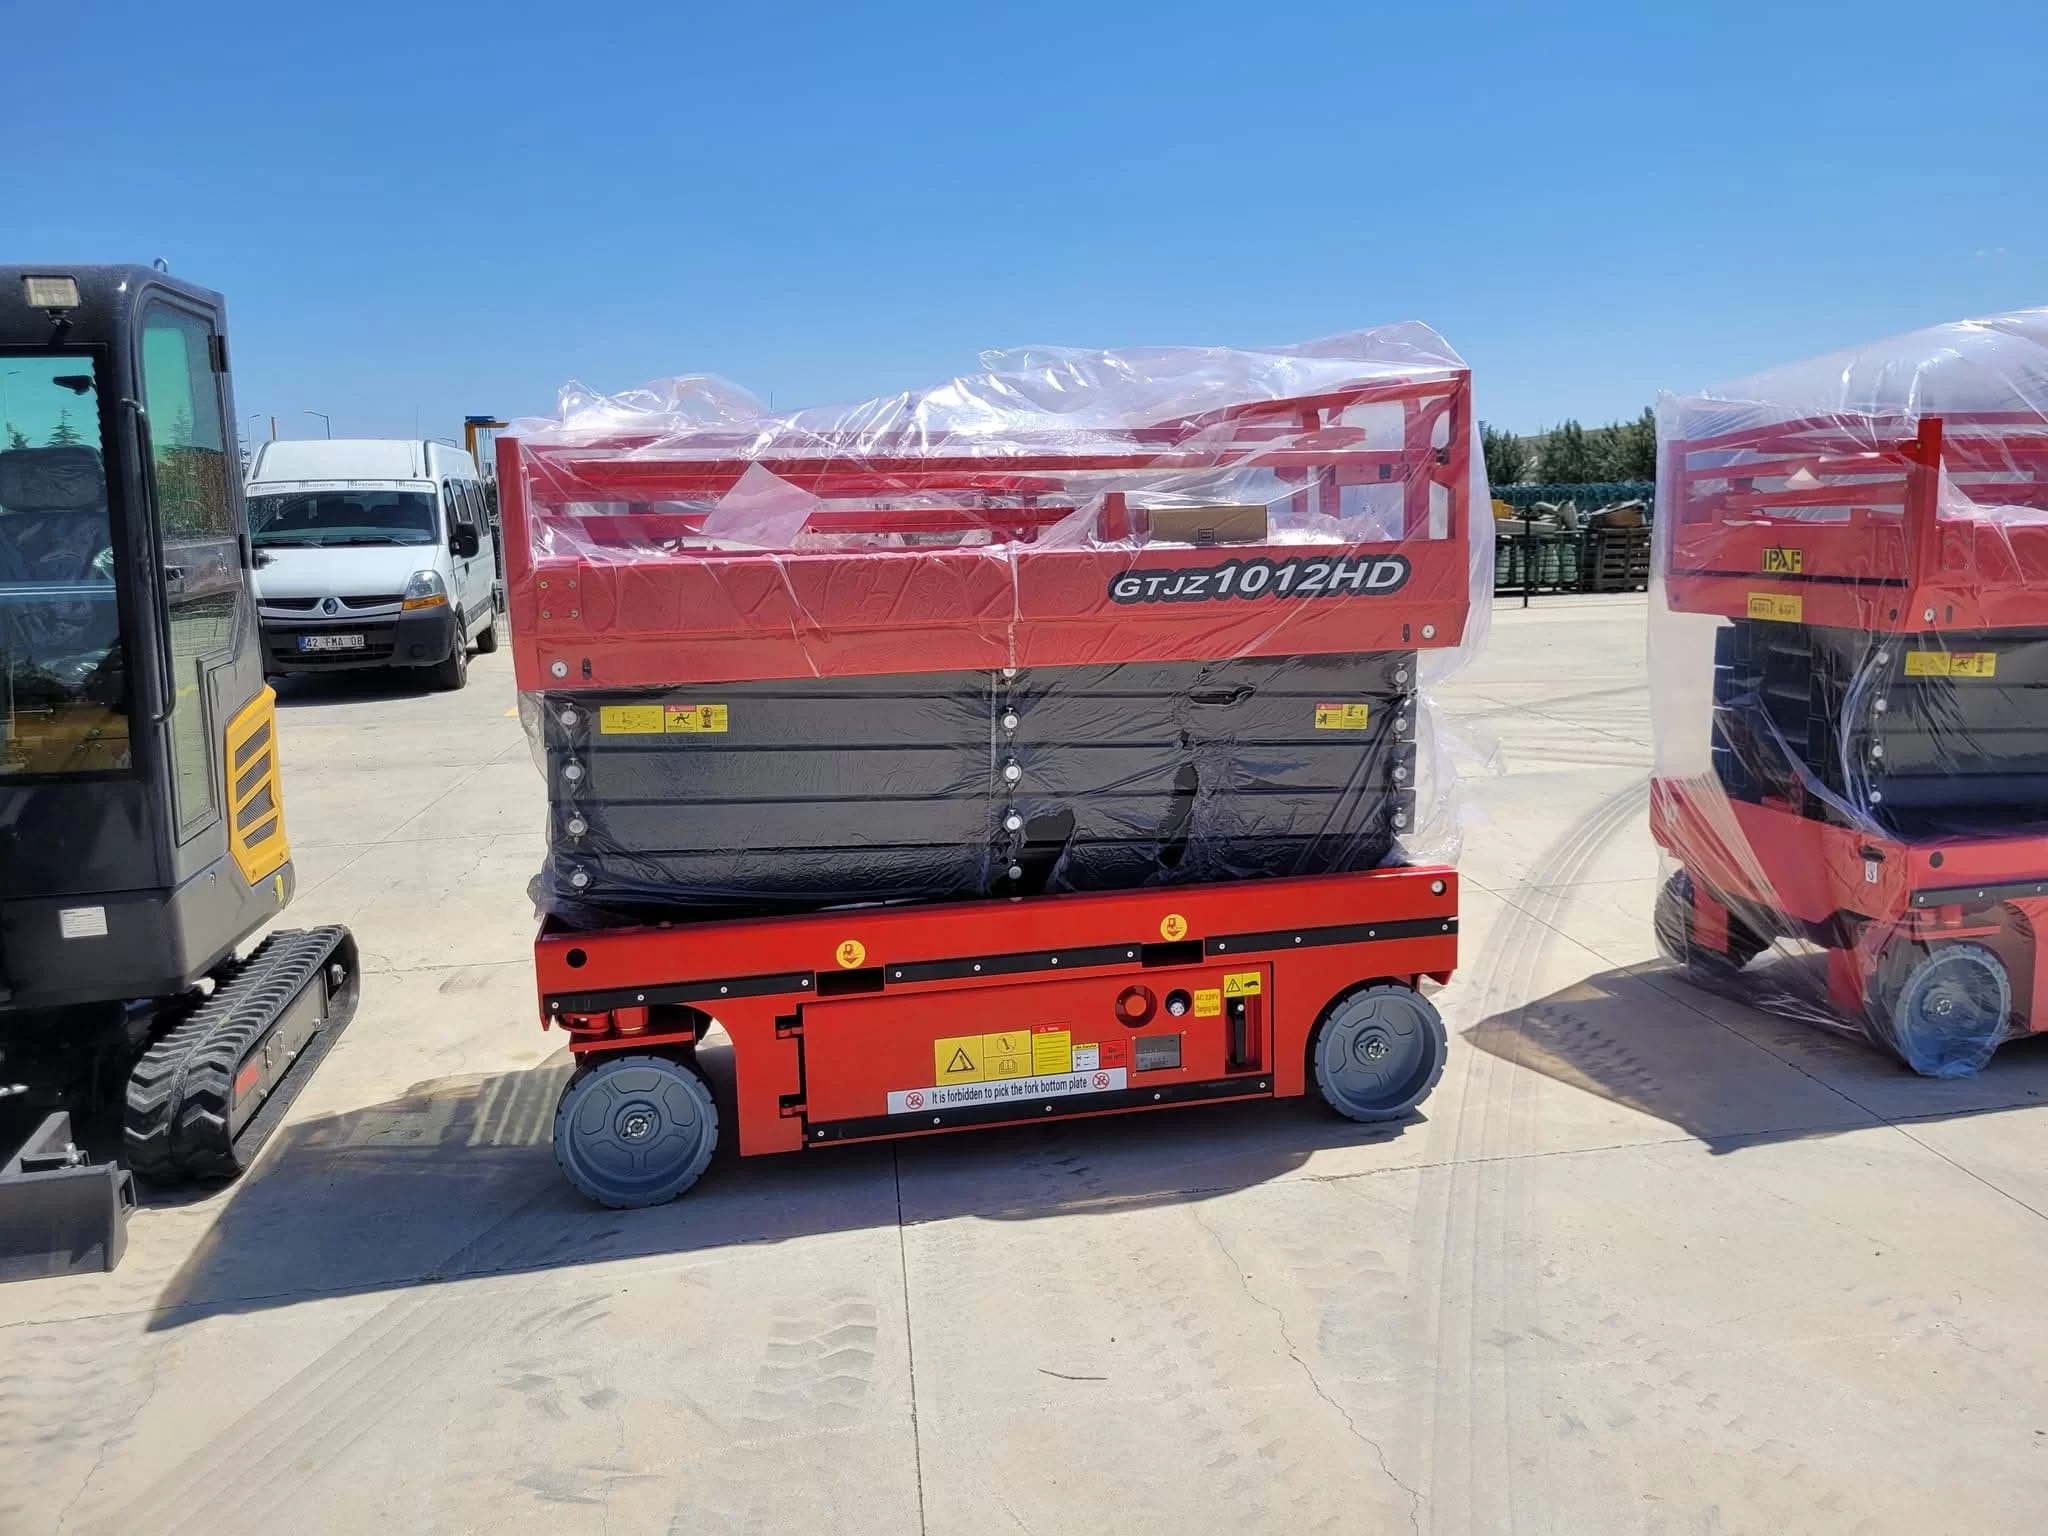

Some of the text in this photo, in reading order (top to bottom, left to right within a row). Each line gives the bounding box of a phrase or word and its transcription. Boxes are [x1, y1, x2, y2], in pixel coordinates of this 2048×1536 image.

[1763, 548, 1801, 571] IPAF
[306, 638, 318, 647] 42
[932, 1075, 1087, 1104] It is forbidden to pick the fork bottom plate
